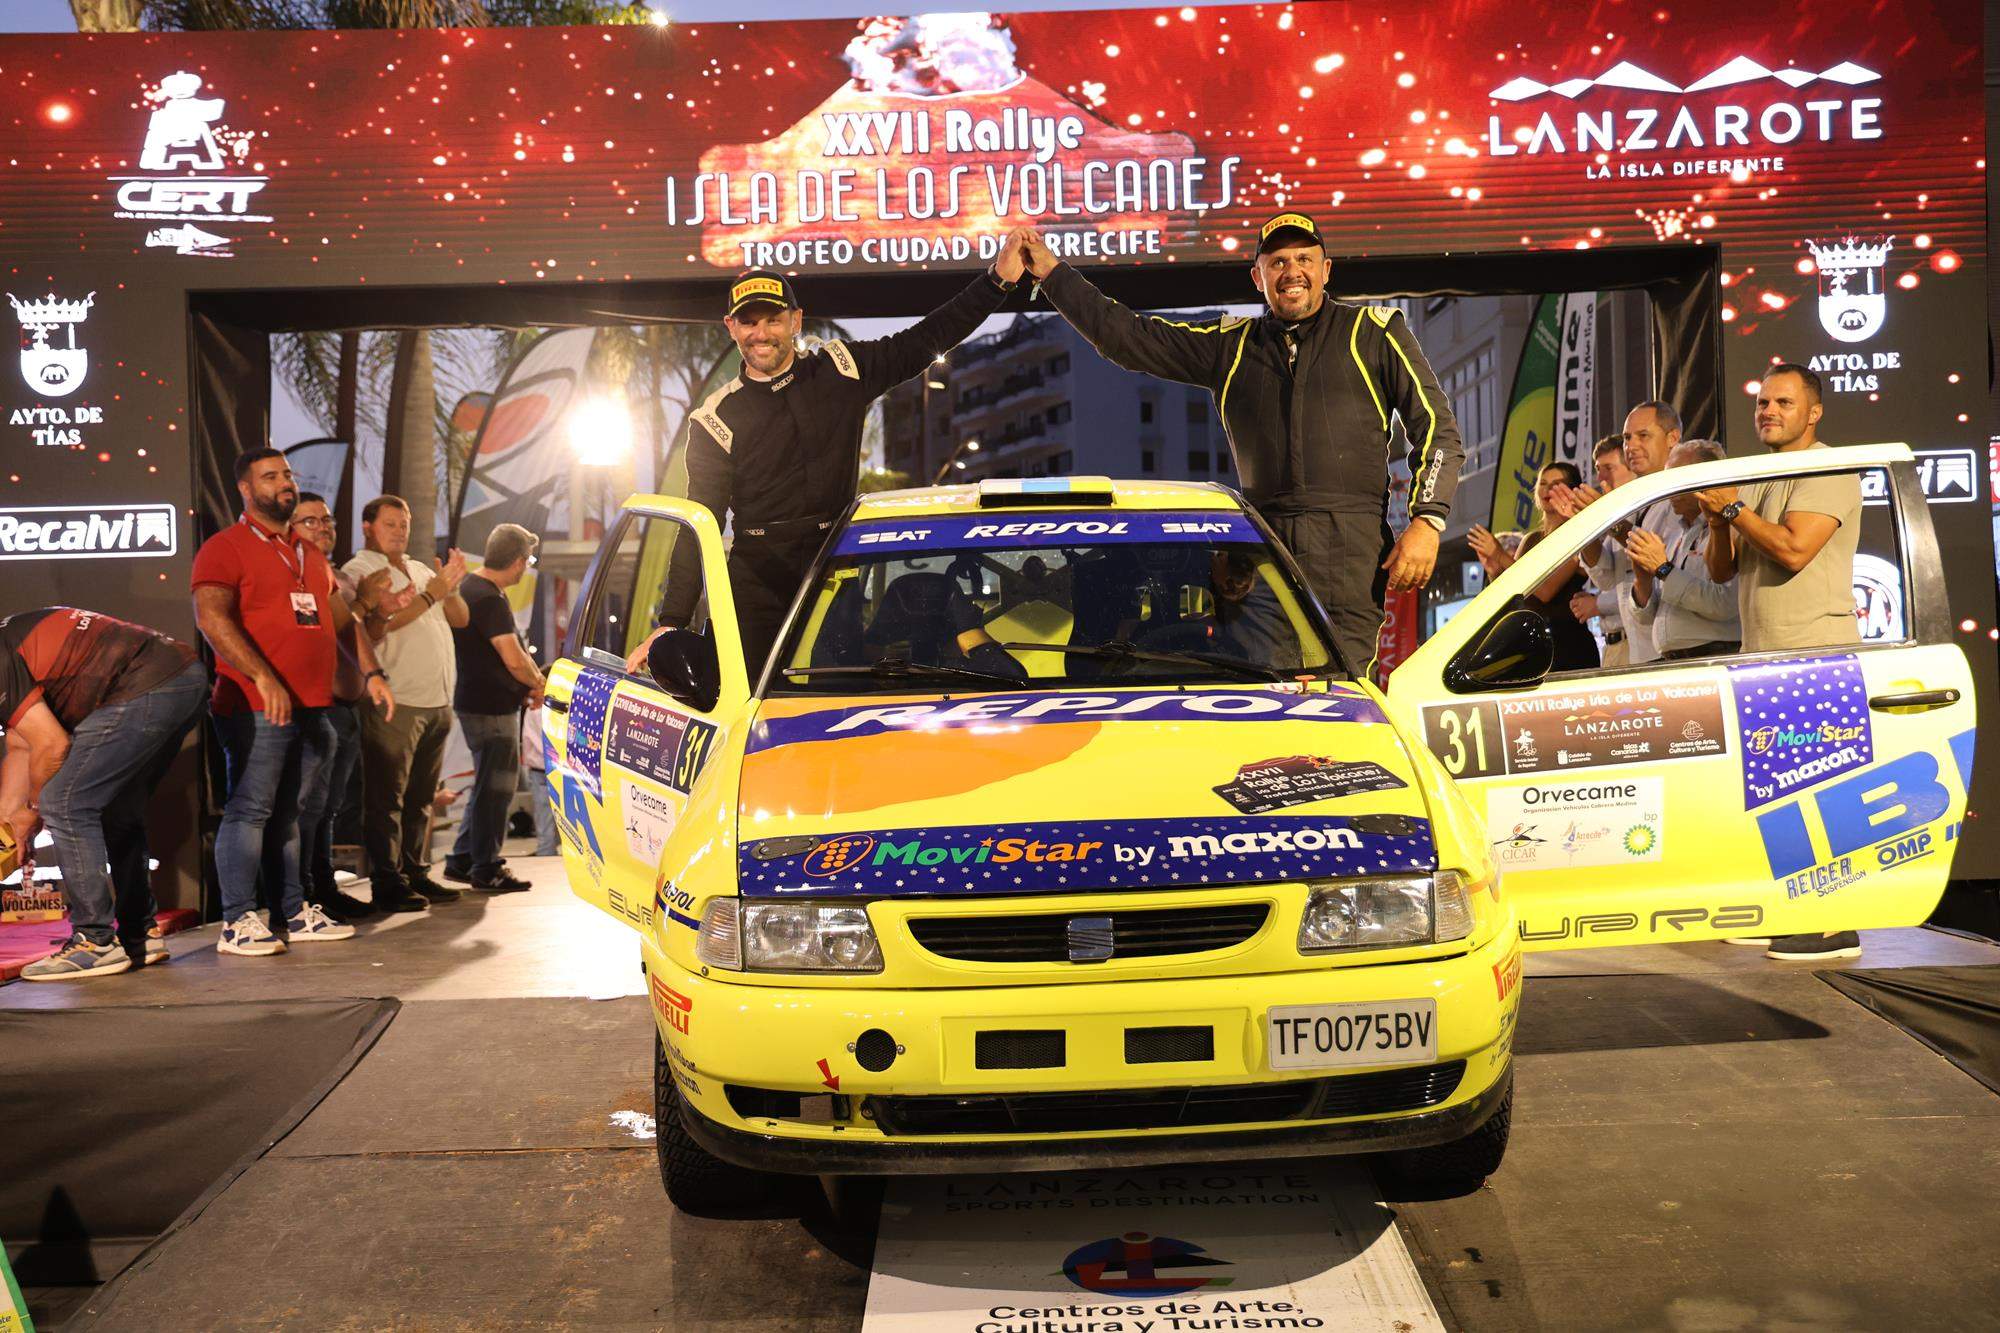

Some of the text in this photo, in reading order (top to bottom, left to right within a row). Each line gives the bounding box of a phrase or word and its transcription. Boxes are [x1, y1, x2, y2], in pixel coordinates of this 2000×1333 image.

[822, 107, 1085, 163] XXVII Rallye
[1489, 97, 1883, 156] LANZAROTE
[1586, 156, 1784, 179] LA ISLA DIFERENTE
[117, 181, 267, 213] CERT
[666, 156, 1242, 226] ISLA DE LOS VOLCANES
[739, 238, 853, 267] TROFEO
[861, 235, 970, 263] CIUDAD
[1044, 229, 1161, 258] RRECIFE
[736, 283, 779, 297] PIRELLI
[1808, 352, 1900, 372] AYTO. DE
[1830, 372, 1879, 392] TÍAS
[9, 407, 103, 425] AYTO. DE
[32, 425, 82, 446] TÍAS
[0, 513, 135, 552] Recalvi
[858, 521, 1233, 545] SEAT REPSOL SEAT
[826, 694, 1345, 733] REPSOL
[1502, 701, 1545, 715] XXVII
[1547, 697, 1585, 711] Rallye
[1615, 692, 1632, 704] de
[1636, 690, 1657, 702] Los
[626, 727, 660, 749] LANZAROTE
[1564, 716, 1664, 736] LANZAROTE
[1777, 725, 1864, 747] MoviStar
[1439, 706, 1488, 775] 31
[678, 724, 709, 790] 31
[1237, 766, 1285, 781] XXVII
[1243, 775, 1289, 788] Rallye
[1755, 747, 1857, 799] by maxon
[1270, 783, 1290, 791] de
[1523, 784, 1637, 804] Orvecame
[631, 785, 667, 815] Orvecame
[1644, 811, 1658, 822] bp
[873, 826, 1363, 867] MoviStar by maxon
[1502, 848, 1536, 860] CICAR
[1877, 833, 1932, 865] OMP
[1786, 857, 1853, 900] REIGER
[1519, 905, 1763, 941] UPRA
[651, 972, 693, 1036] PIRELLI
[1273, 1011, 1431, 1055] TF0075BV
[945, 1173, 1313, 1198] LANZAROTE
[945, 1193, 1320, 1212] SPORTS DESTINATION
[988, 1299, 1304, 1319] Centros de Arte,
[975, 1319, 1124, 1333] Cultura
[1162, 1315, 1325, 1331] Turismo
